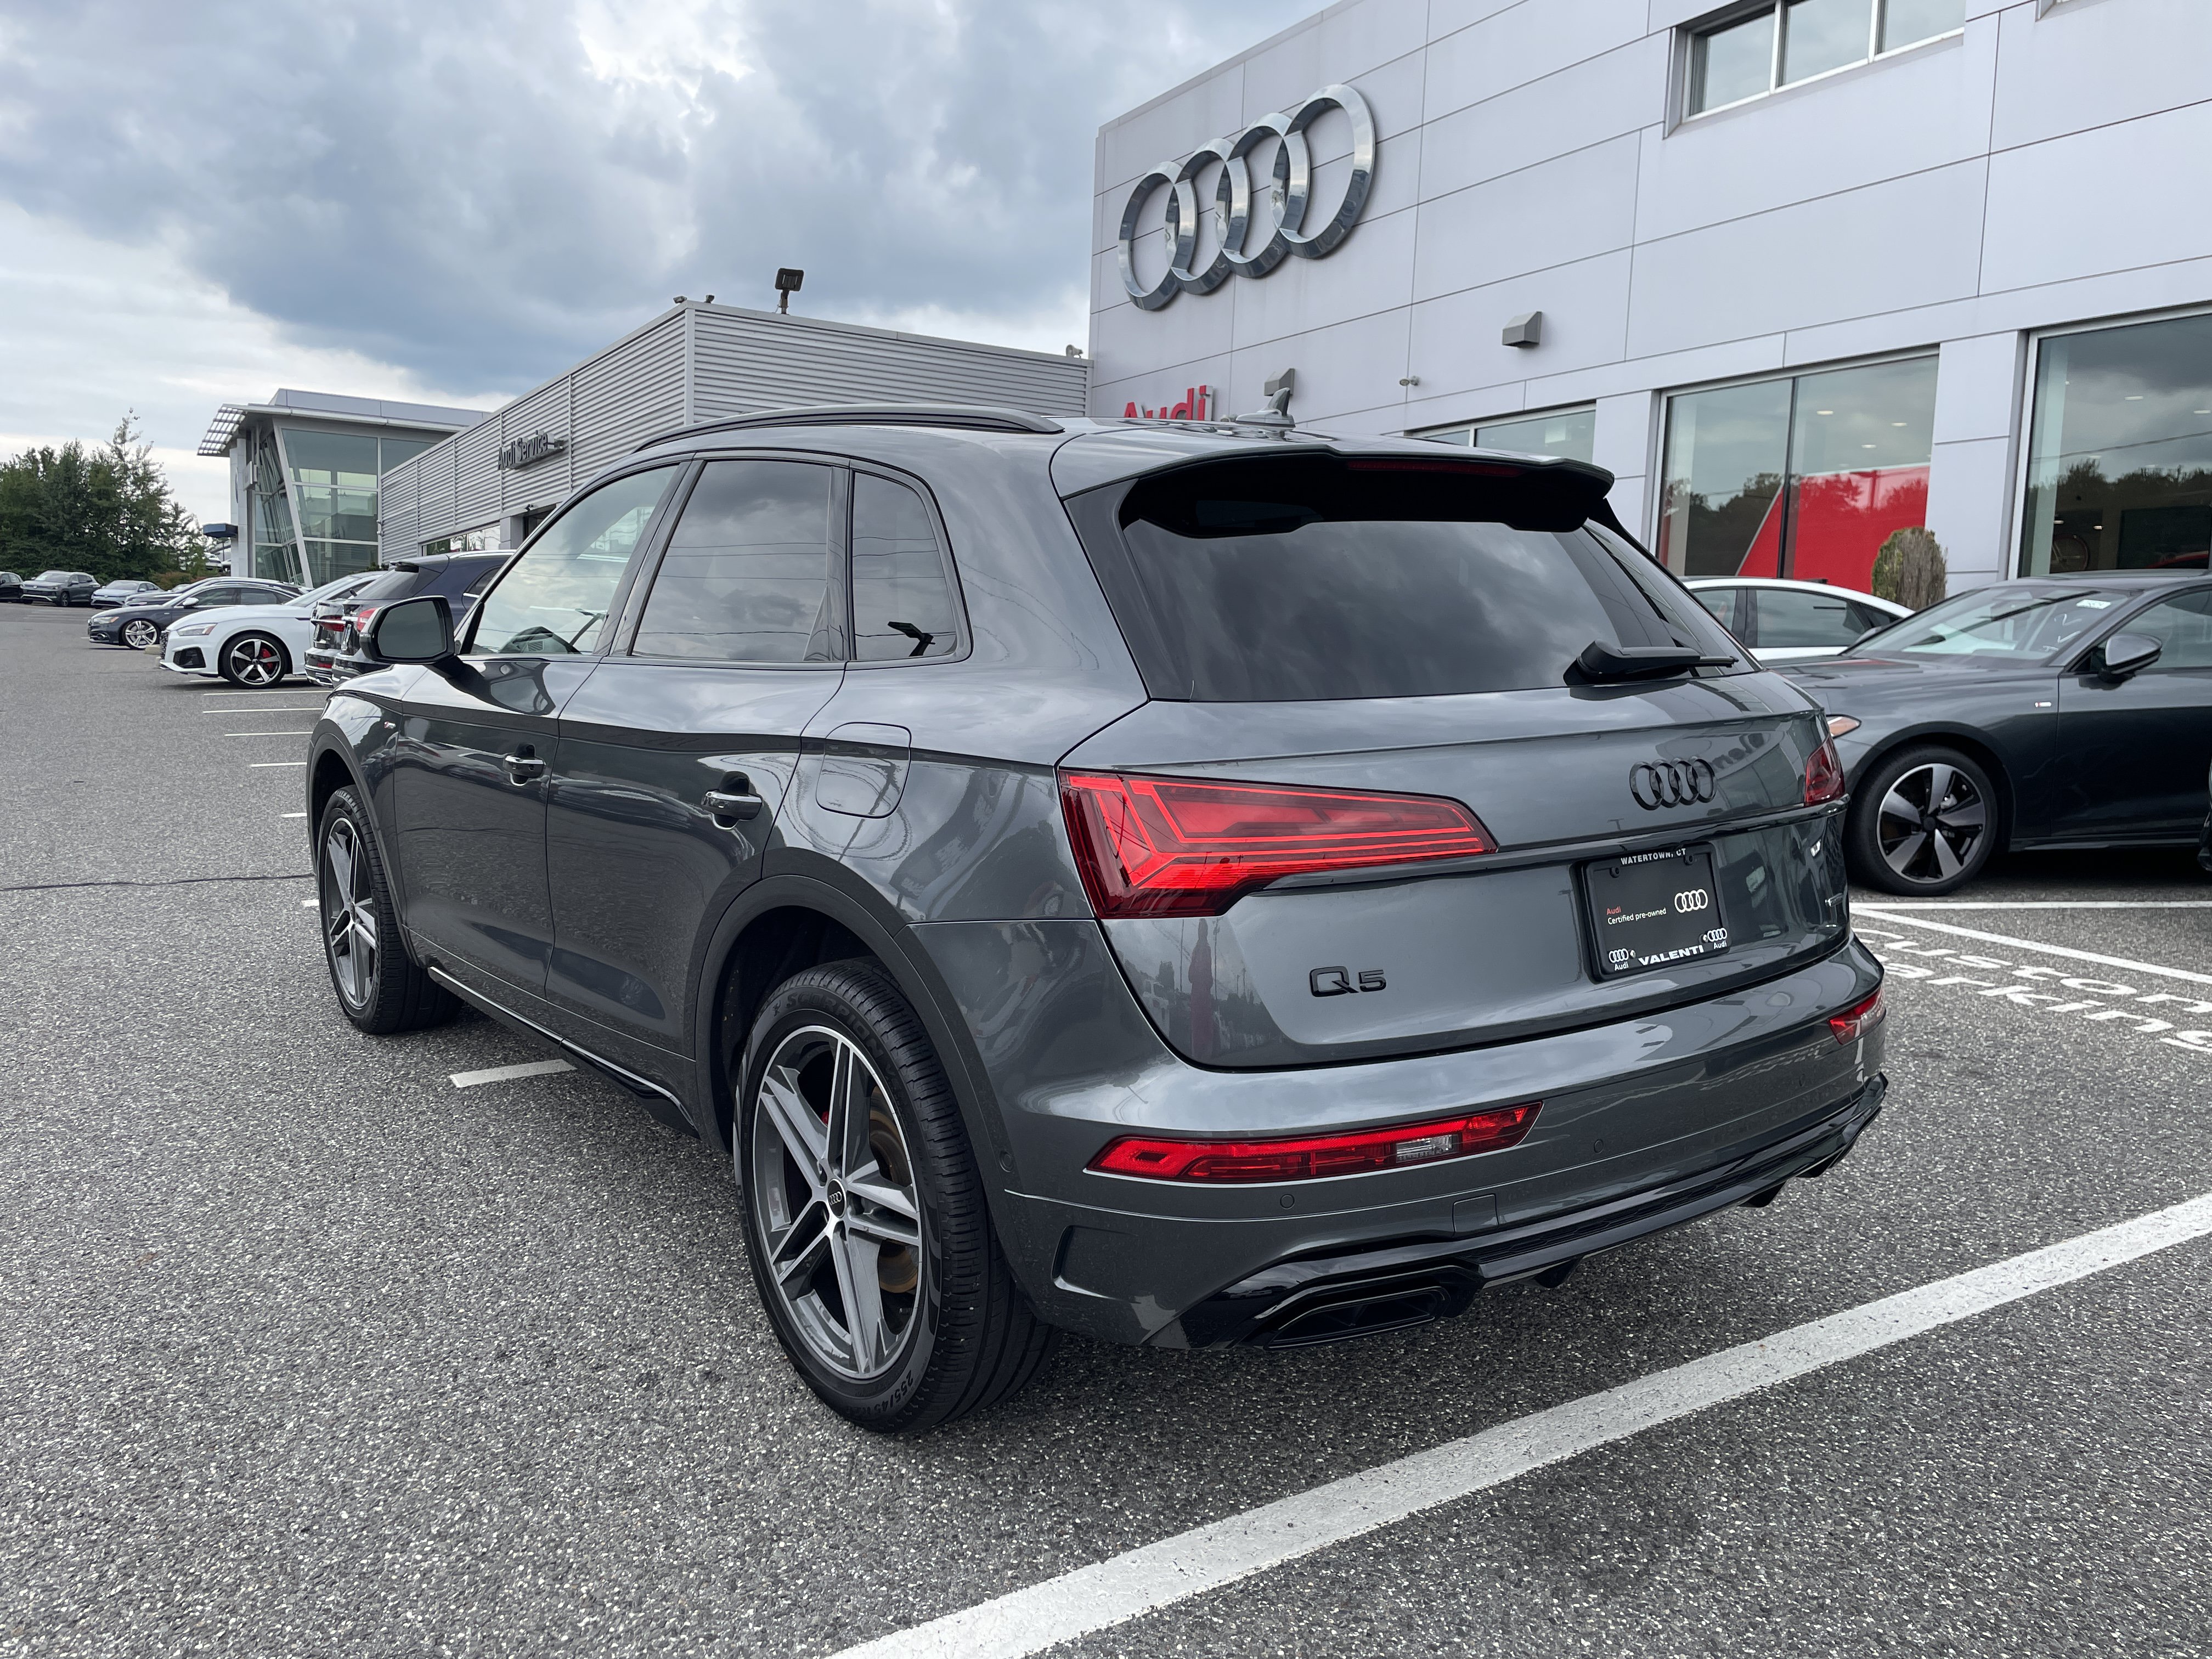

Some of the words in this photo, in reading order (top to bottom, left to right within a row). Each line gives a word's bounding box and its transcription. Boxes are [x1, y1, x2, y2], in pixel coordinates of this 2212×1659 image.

[1124, 385, 1214, 421] di
[498, 440, 516, 470] Audi
[517, 430, 549, 462] Service
[1621, 851, 1673, 865] WATERTOWN,
[1676, 848, 1686, 856] CT
[1606, 906, 1622, 915] Audi
[1607, 913, 1634, 925] Certified
[1635, 907, 1667, 921] pre-owned
[1638, 945, 1704, 966] VALENTI
[1713, 940, 1727, 950] Audi
[1615, 961, 1629, 971] Audi
[1309, 966, 1387, 997] Q5
[786, 991, 884, 1058] SCORPION
[873, 1369, 913, 1414] 255/45
